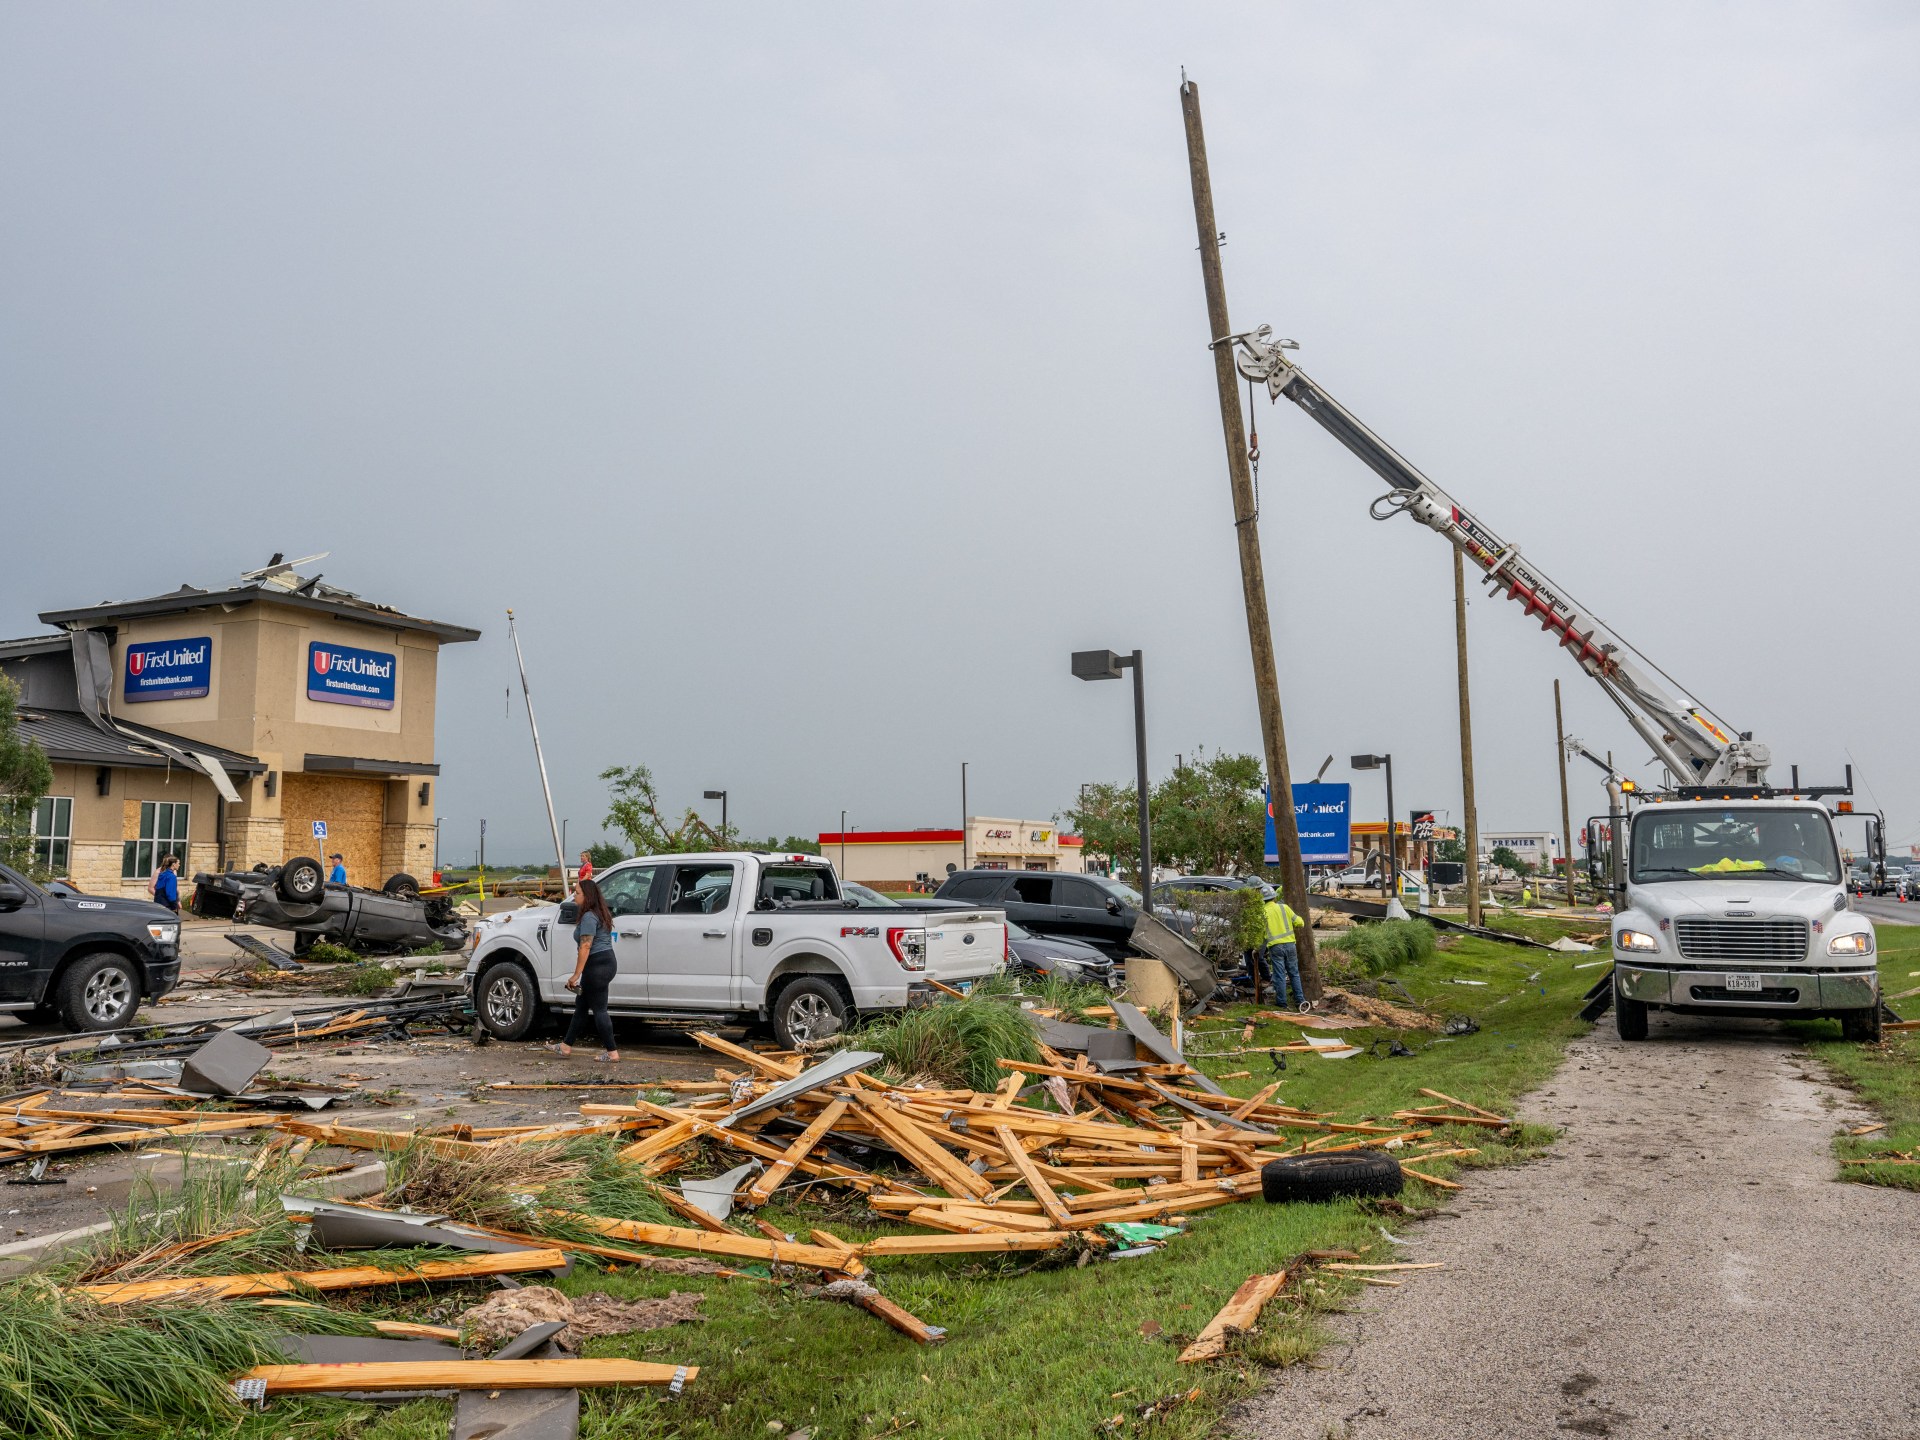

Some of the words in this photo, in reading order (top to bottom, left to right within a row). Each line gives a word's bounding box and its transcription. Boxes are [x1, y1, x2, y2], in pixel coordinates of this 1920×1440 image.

[1471, 526, 1500, 554] TEREX
[140, 675, 193, 687] firstunitedbank.com
[325, 678, 380, 694] firstunitedbank.com
[1418, 829, 1433, 839] Hu
[1492, 839, 1536, 847] PREMIER
[840, 926, 880, 938] FX4
